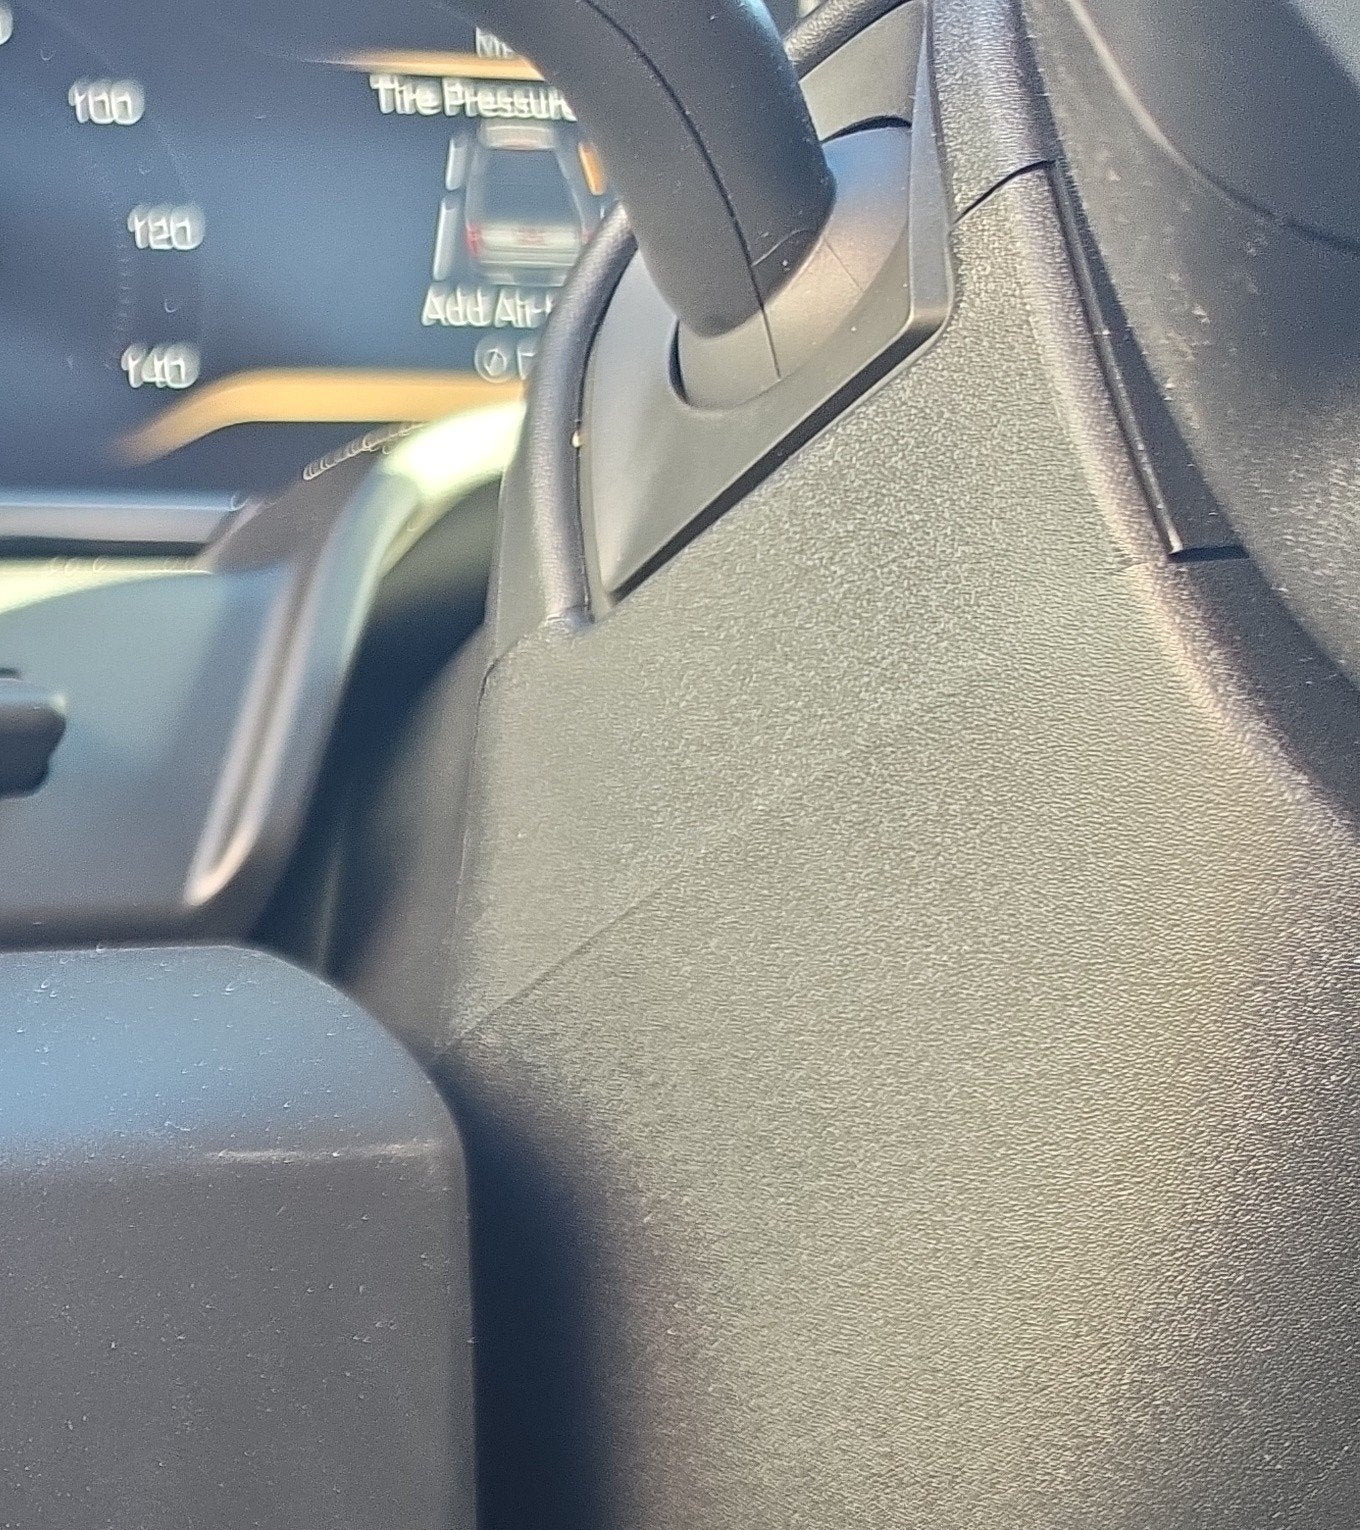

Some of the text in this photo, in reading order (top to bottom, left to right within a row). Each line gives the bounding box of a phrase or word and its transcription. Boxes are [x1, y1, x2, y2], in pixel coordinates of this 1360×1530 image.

[68, 80, 145, 126] 100
[370, 73, 443, 115] Tire
[127, 202, 205, 251] 120
[421, 281, 493, 327] Add
[120, 342, 202, 389] 140
